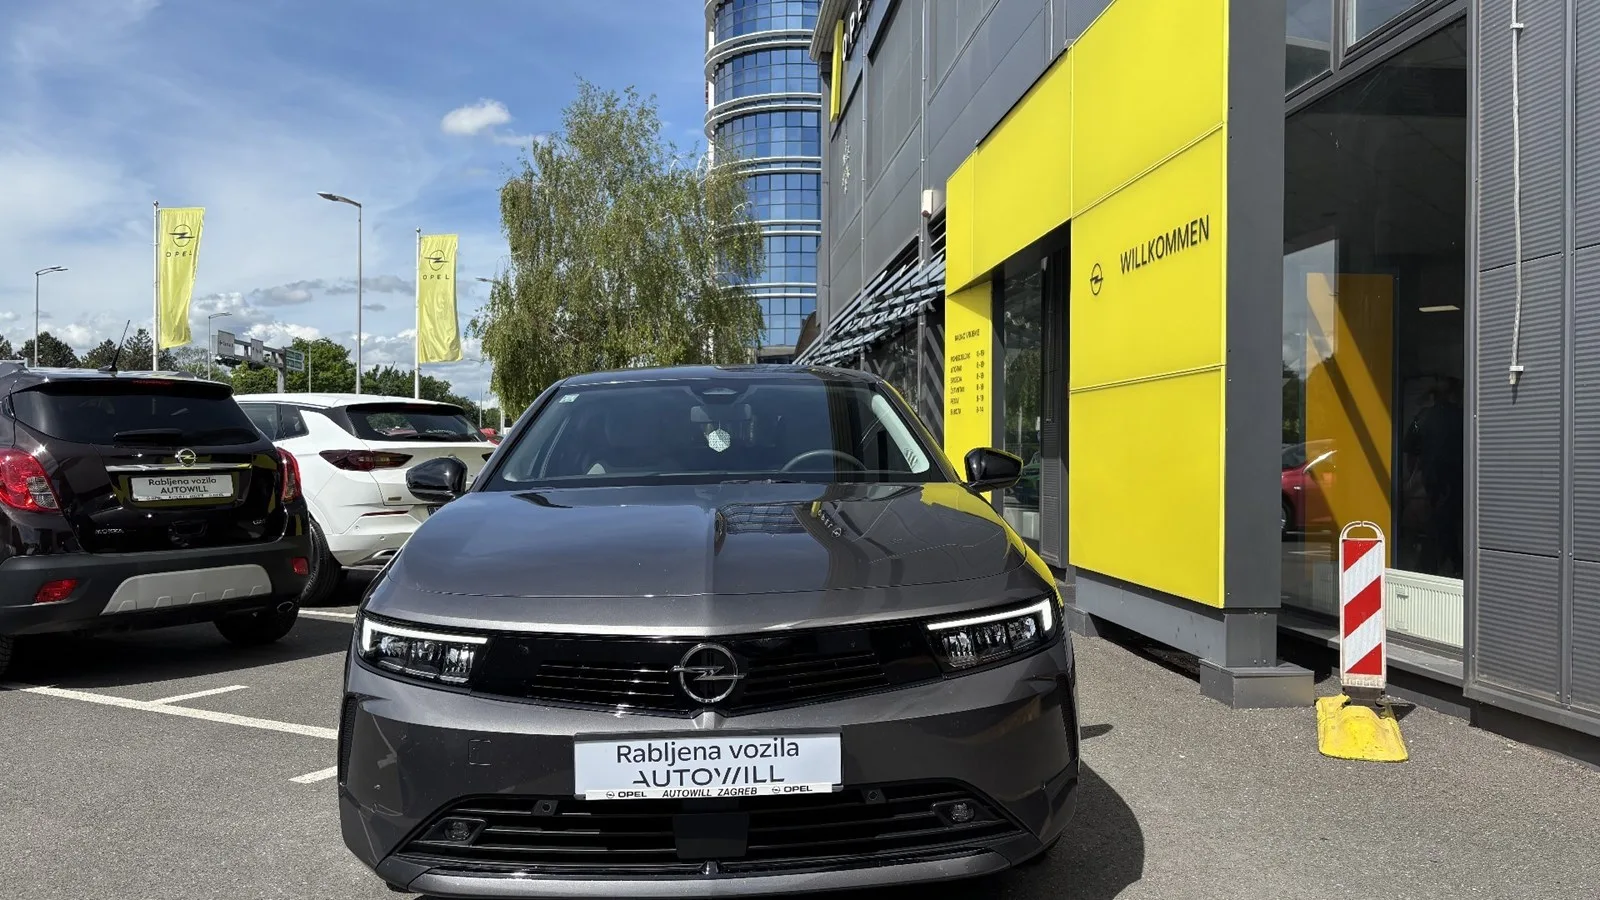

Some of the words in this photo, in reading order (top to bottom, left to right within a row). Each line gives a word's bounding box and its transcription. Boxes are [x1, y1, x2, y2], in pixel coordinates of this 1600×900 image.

[1120, 214, 1209, 275] WILLKOMMEN
[148, 478, 189, 486] Rabljena
[191, 476, 217, 484] vozila
[160, 485, 209, 494] AUTOWILL
[616, 741, 721, 767] Rabljena
[728, 737, 800, 759] vozila
[632, 764, 785, 788] AUTOWILL
[662, 788, 712, 798] AUTOWILL
[717, 787, 758, 797] ZAGREB
[783, 784, 813, 793] OPEL
[617, 790, 648, 799] OPEL
